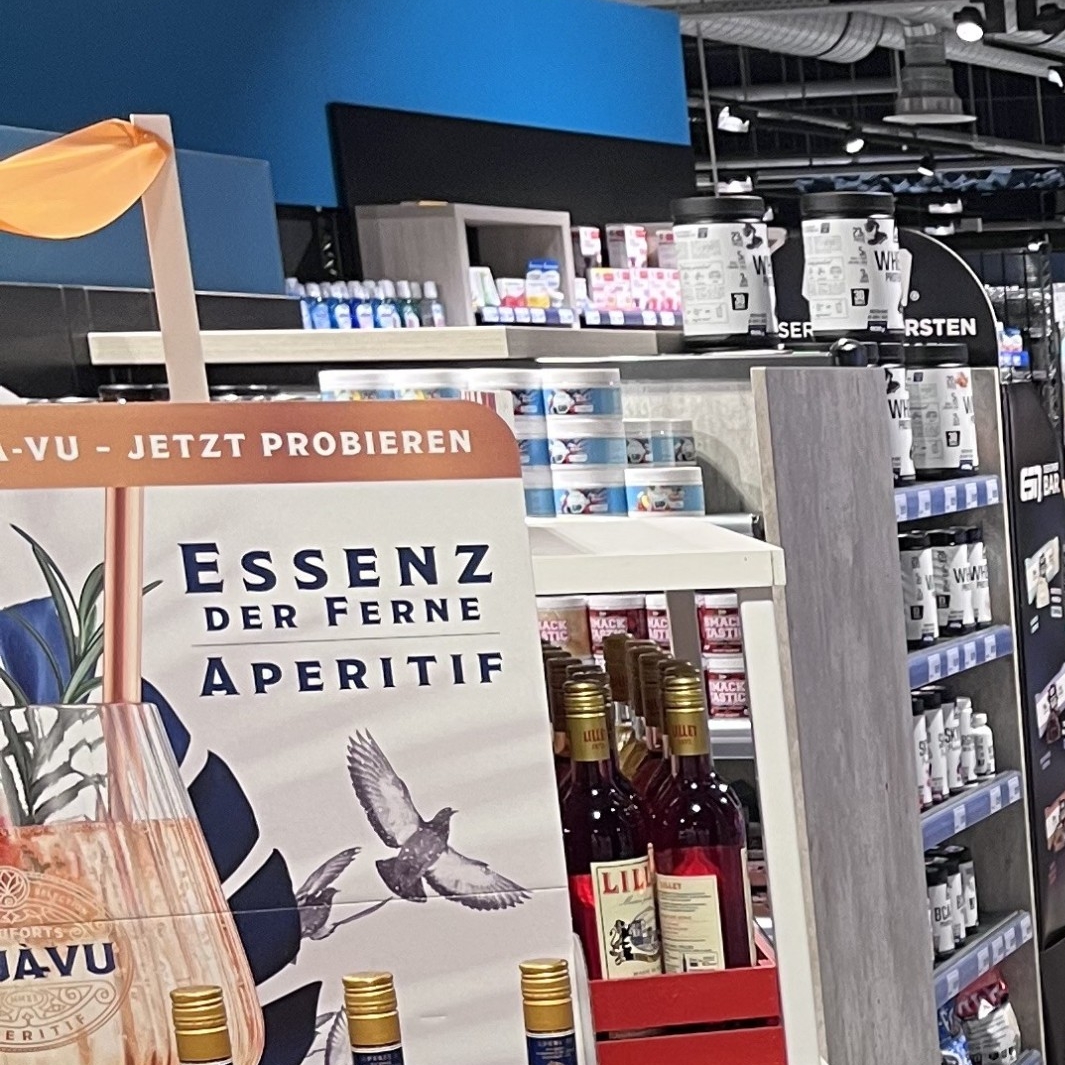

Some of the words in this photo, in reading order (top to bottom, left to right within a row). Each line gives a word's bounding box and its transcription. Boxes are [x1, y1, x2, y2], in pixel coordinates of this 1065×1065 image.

[128, 433, 245, 460] JETZT
[261, 428, 472, 458] PROBIEREN
[178, 543, 493, 595] ESSENZ
[205, 604, 298, 632] DER
[324, 597, 481, 628] FERNE
[200, 652, 503, 698] APERITIF
